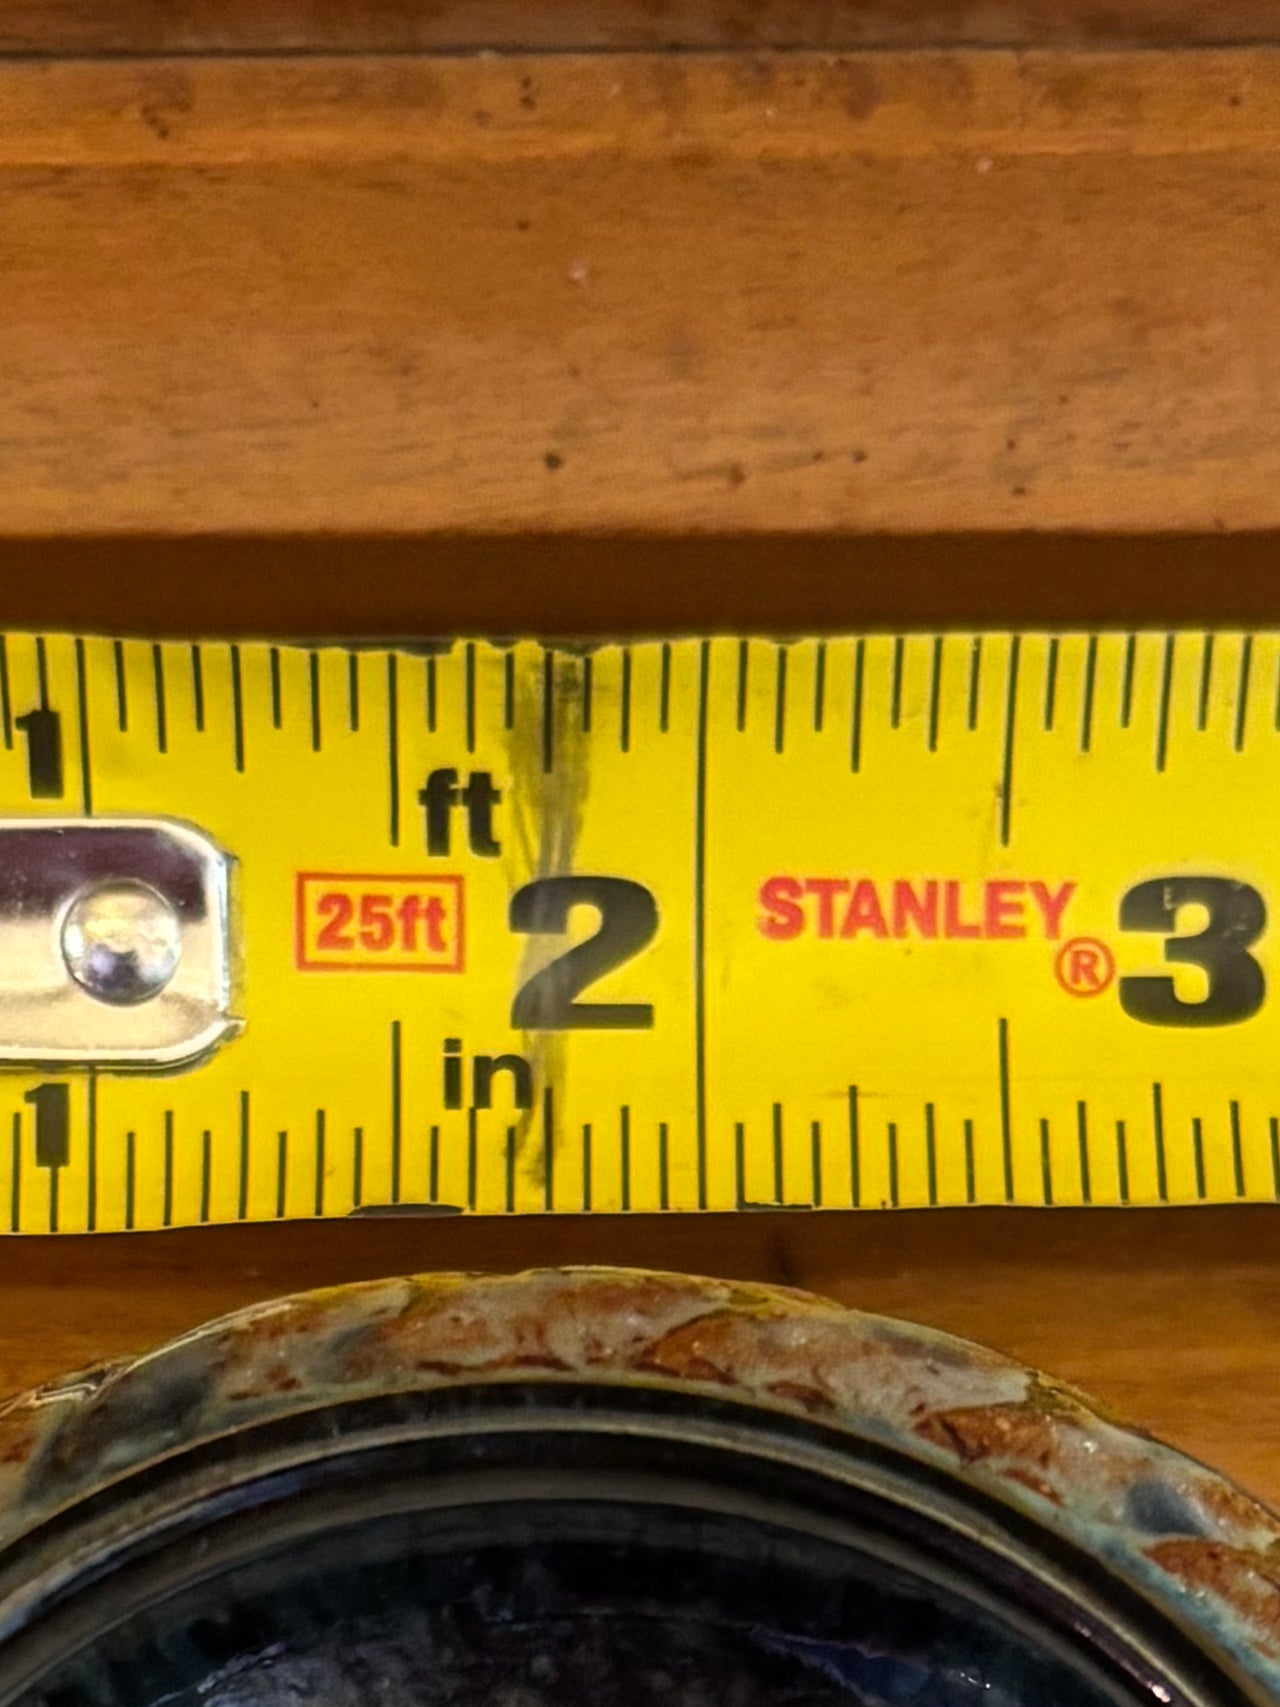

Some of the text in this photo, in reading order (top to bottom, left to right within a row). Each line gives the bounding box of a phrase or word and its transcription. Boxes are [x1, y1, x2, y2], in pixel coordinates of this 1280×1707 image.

[16, 707, 65, 799] 1
[419, 769, 501, 859] ft
[316, 892, 448, 952] 25ft
[511, 876, 659, 1030] 2
[757, 877, 1076, 941] STANLEY
[1117, 876, 1267, 1028] 3
[442, 1037, 532, 1110] in
[24, 1082, 71, 1168] 1
